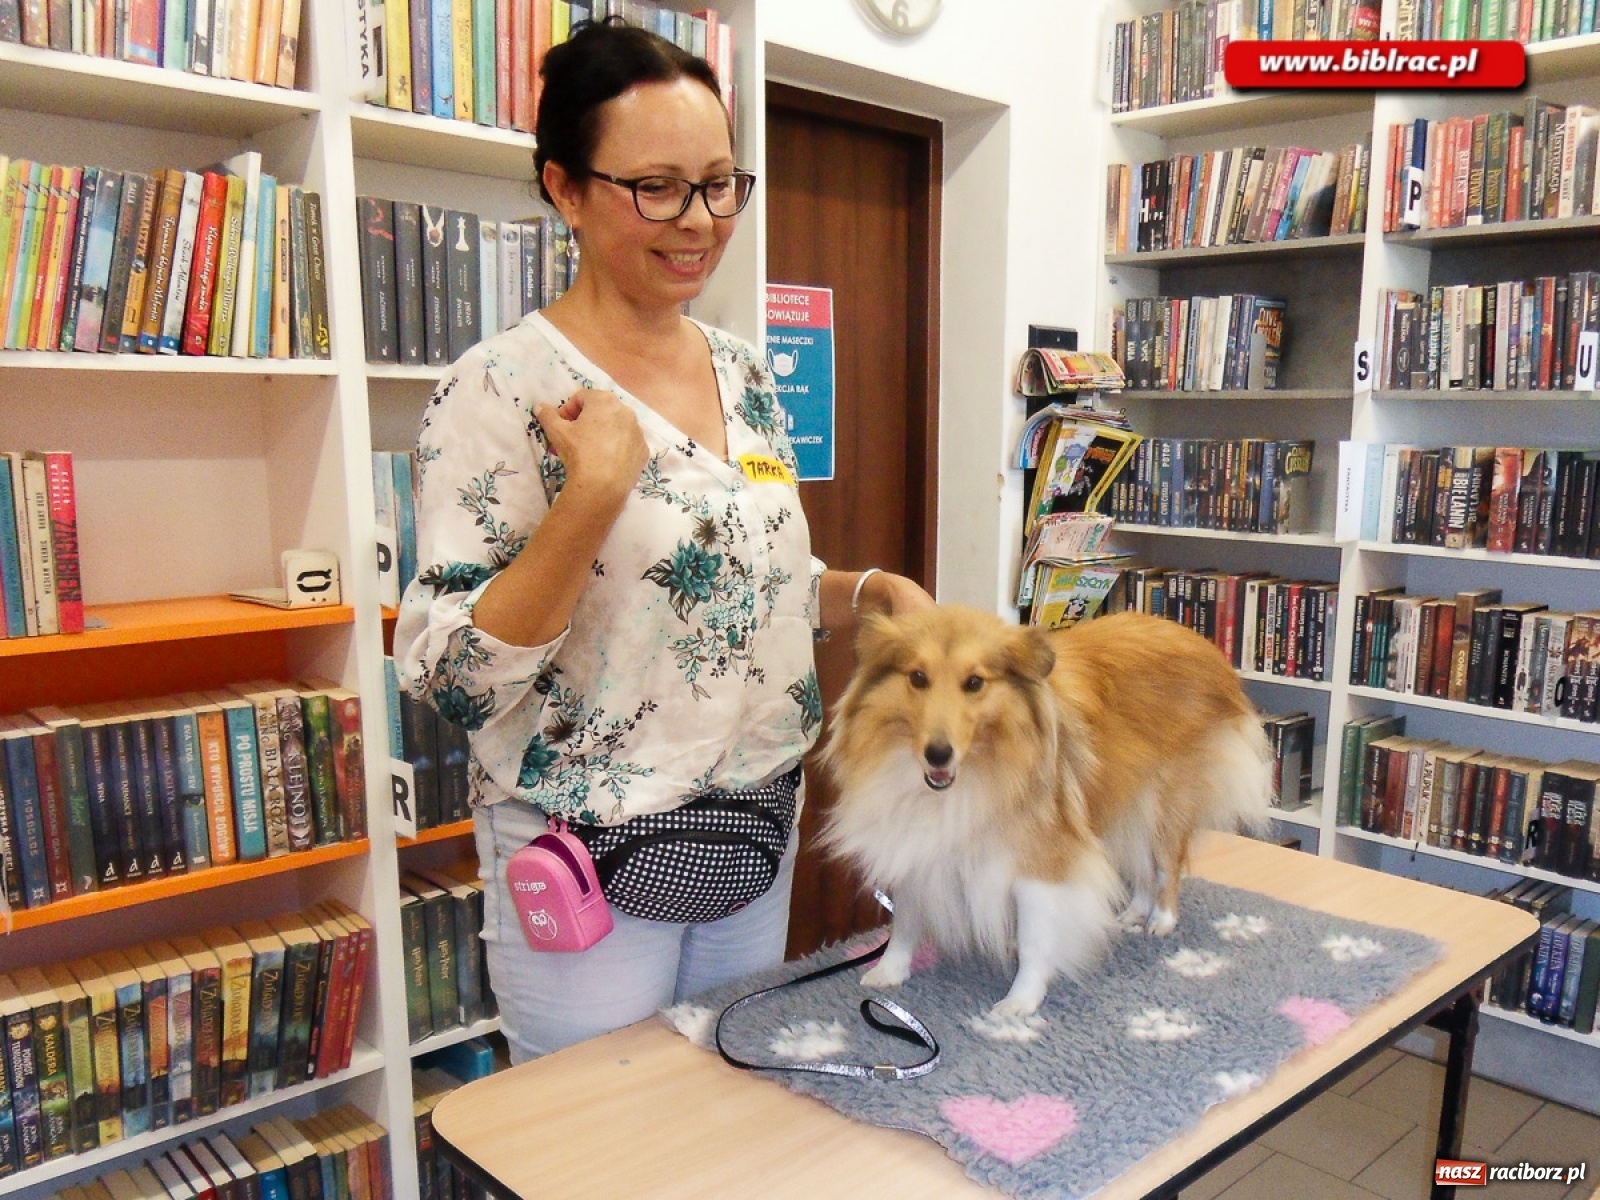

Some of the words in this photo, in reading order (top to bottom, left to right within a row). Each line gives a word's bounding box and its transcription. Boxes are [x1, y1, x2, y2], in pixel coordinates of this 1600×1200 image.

[1409, 180, 1421, 210] P
[1357, 350, 1369, 380] S
[1580, 345, 1592, 378] U
[1456, 650, 1466, 686] CONAN
[208, 741, 220, 760] KTO
[236, 735, 251, 750] PO
[238, 754, 255, 796] PROSTU
[288, 752, 306, 824] KLEJNOT
[391, 774, 412, 821] R
[242, 799, 258, 833] MISJA
[45, 1033, 57, 1076] KALDERA
